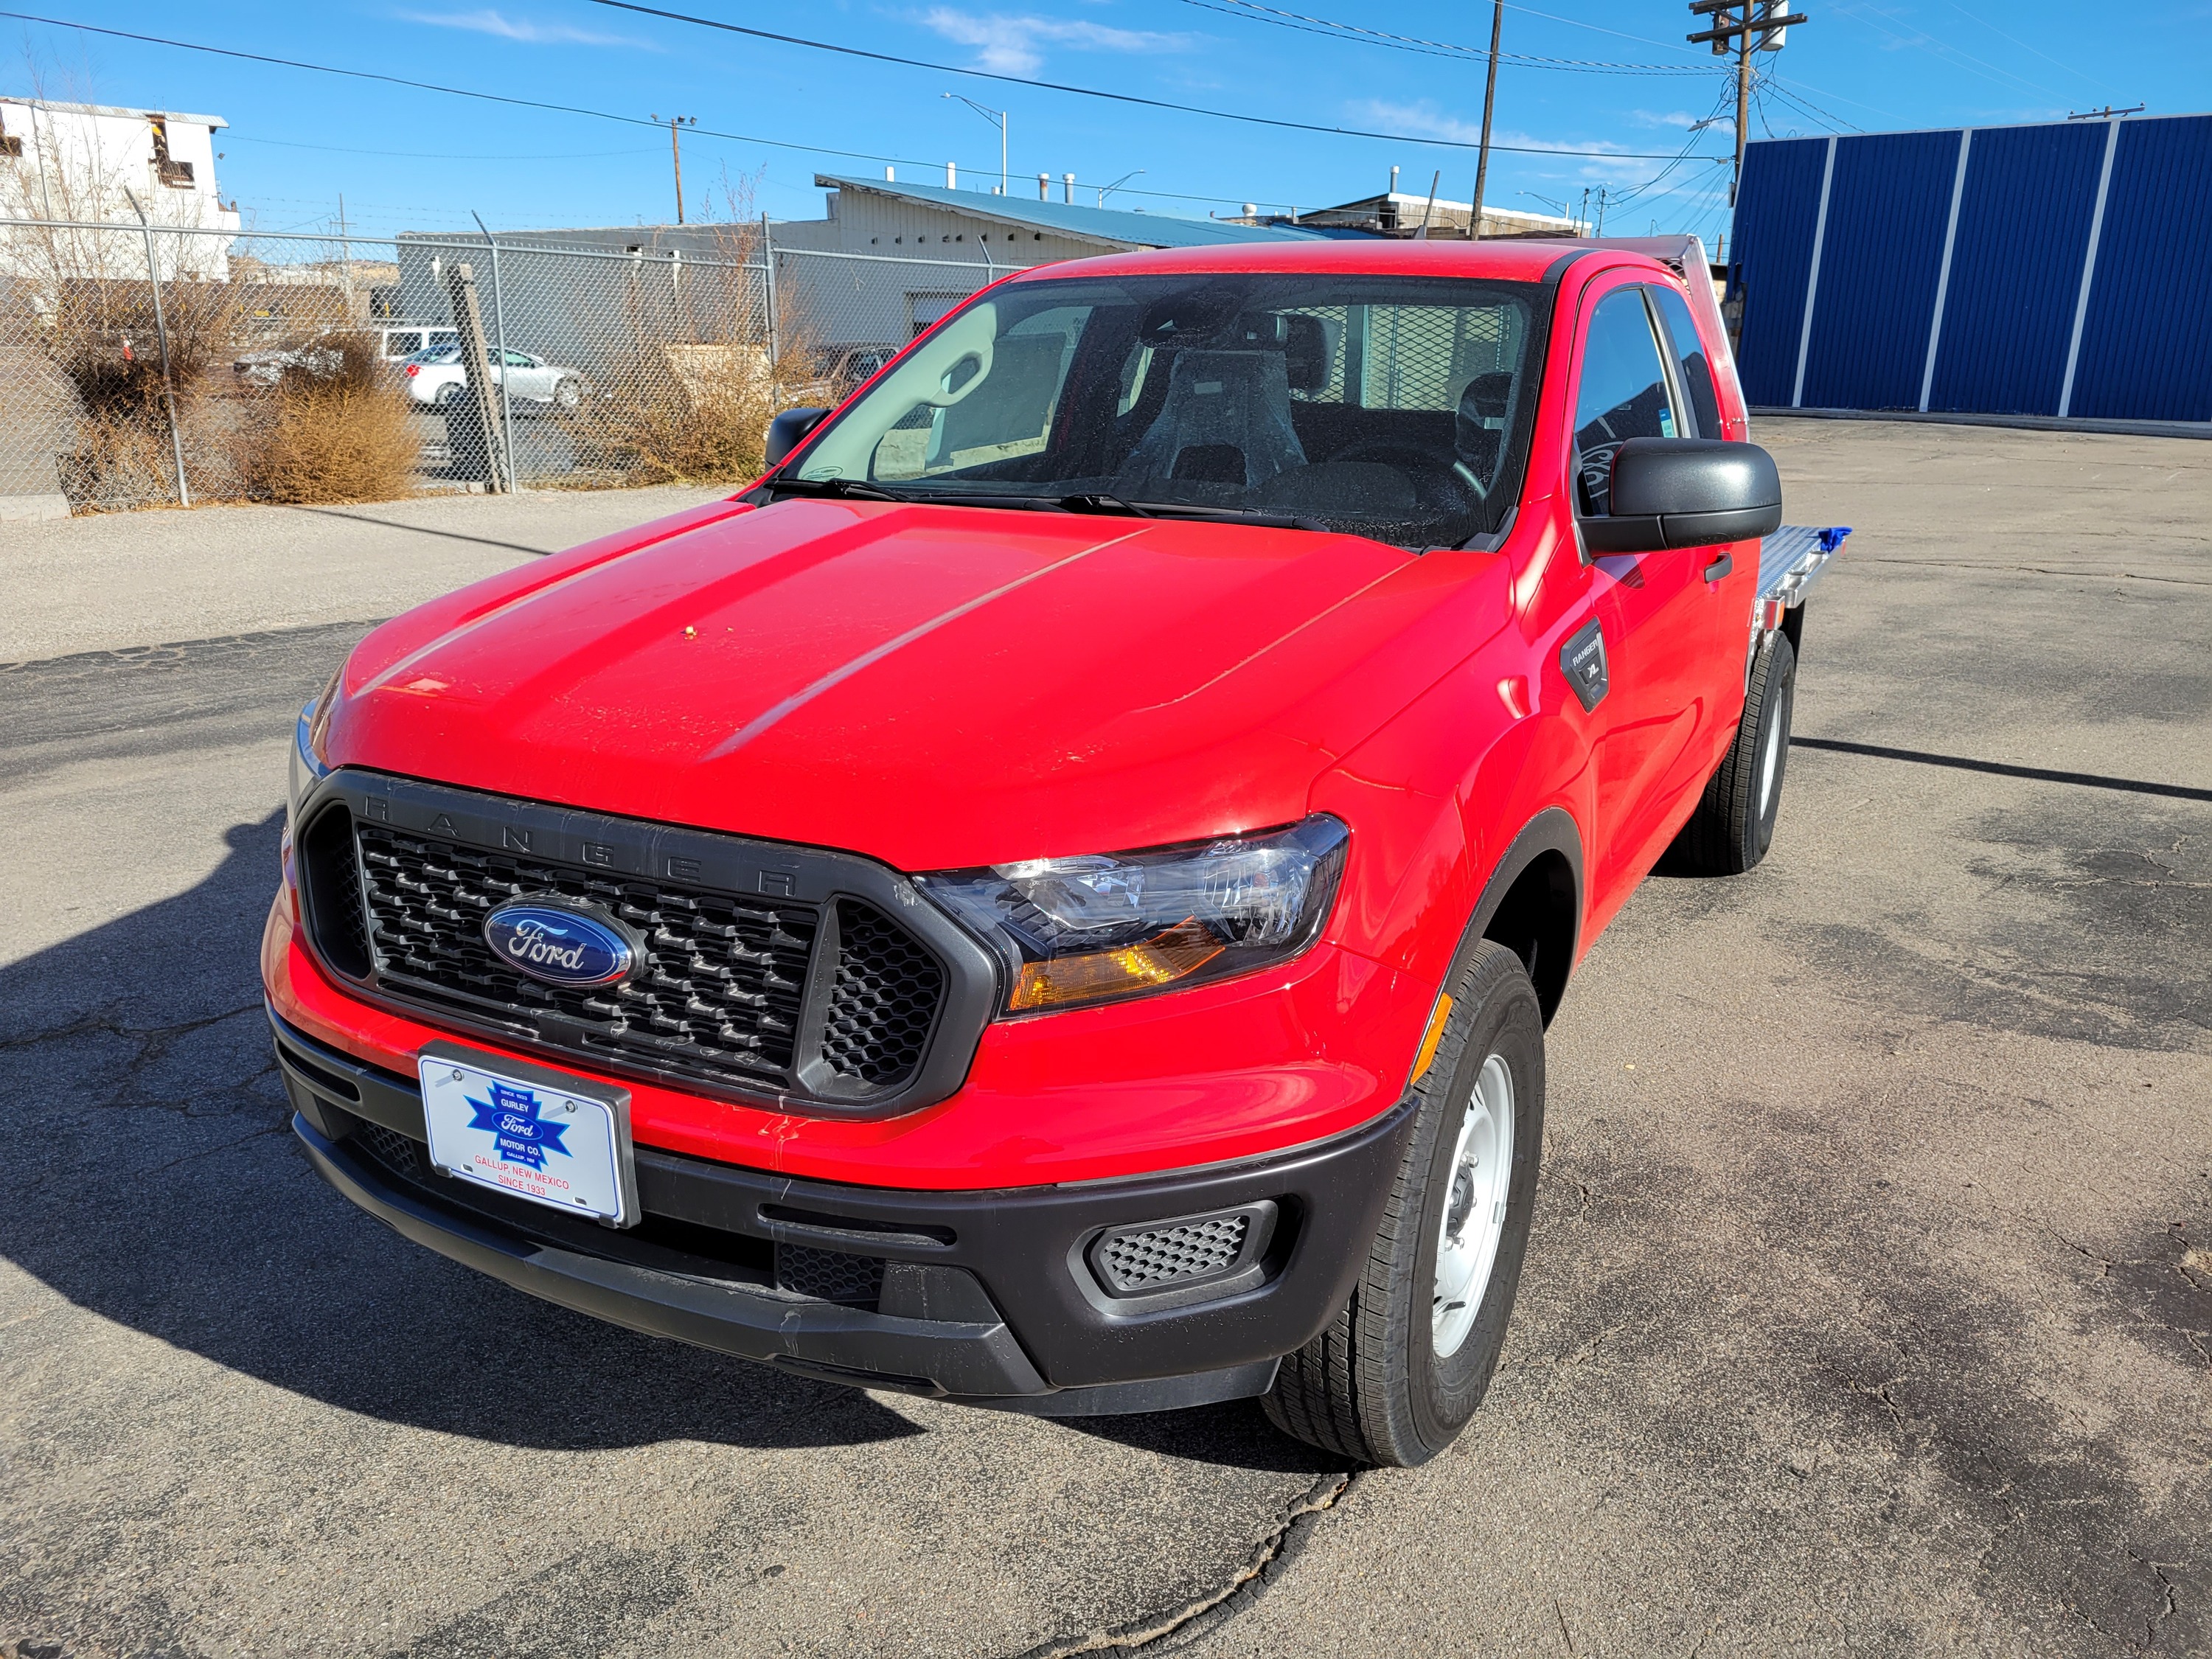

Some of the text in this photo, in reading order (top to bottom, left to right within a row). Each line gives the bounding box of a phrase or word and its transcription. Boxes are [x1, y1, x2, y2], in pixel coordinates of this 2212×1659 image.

[1572, 639, 1598, 667] RANGER
[1587, 663, 1599, 678] XL
[365, 796, 796, 897] RANGER
[508, 919, 588, 970] Ford
[501, 1099, 529, 1113] GURLEY
[501, 1114, 534, 1137] Ford
[500, 1138, 540, 1156] MOTOR CO.
[475, 1155, 569, 1189] GALLUP, NEW MEXICO
[498, 1175, 546, 1196] SINCE 1933
